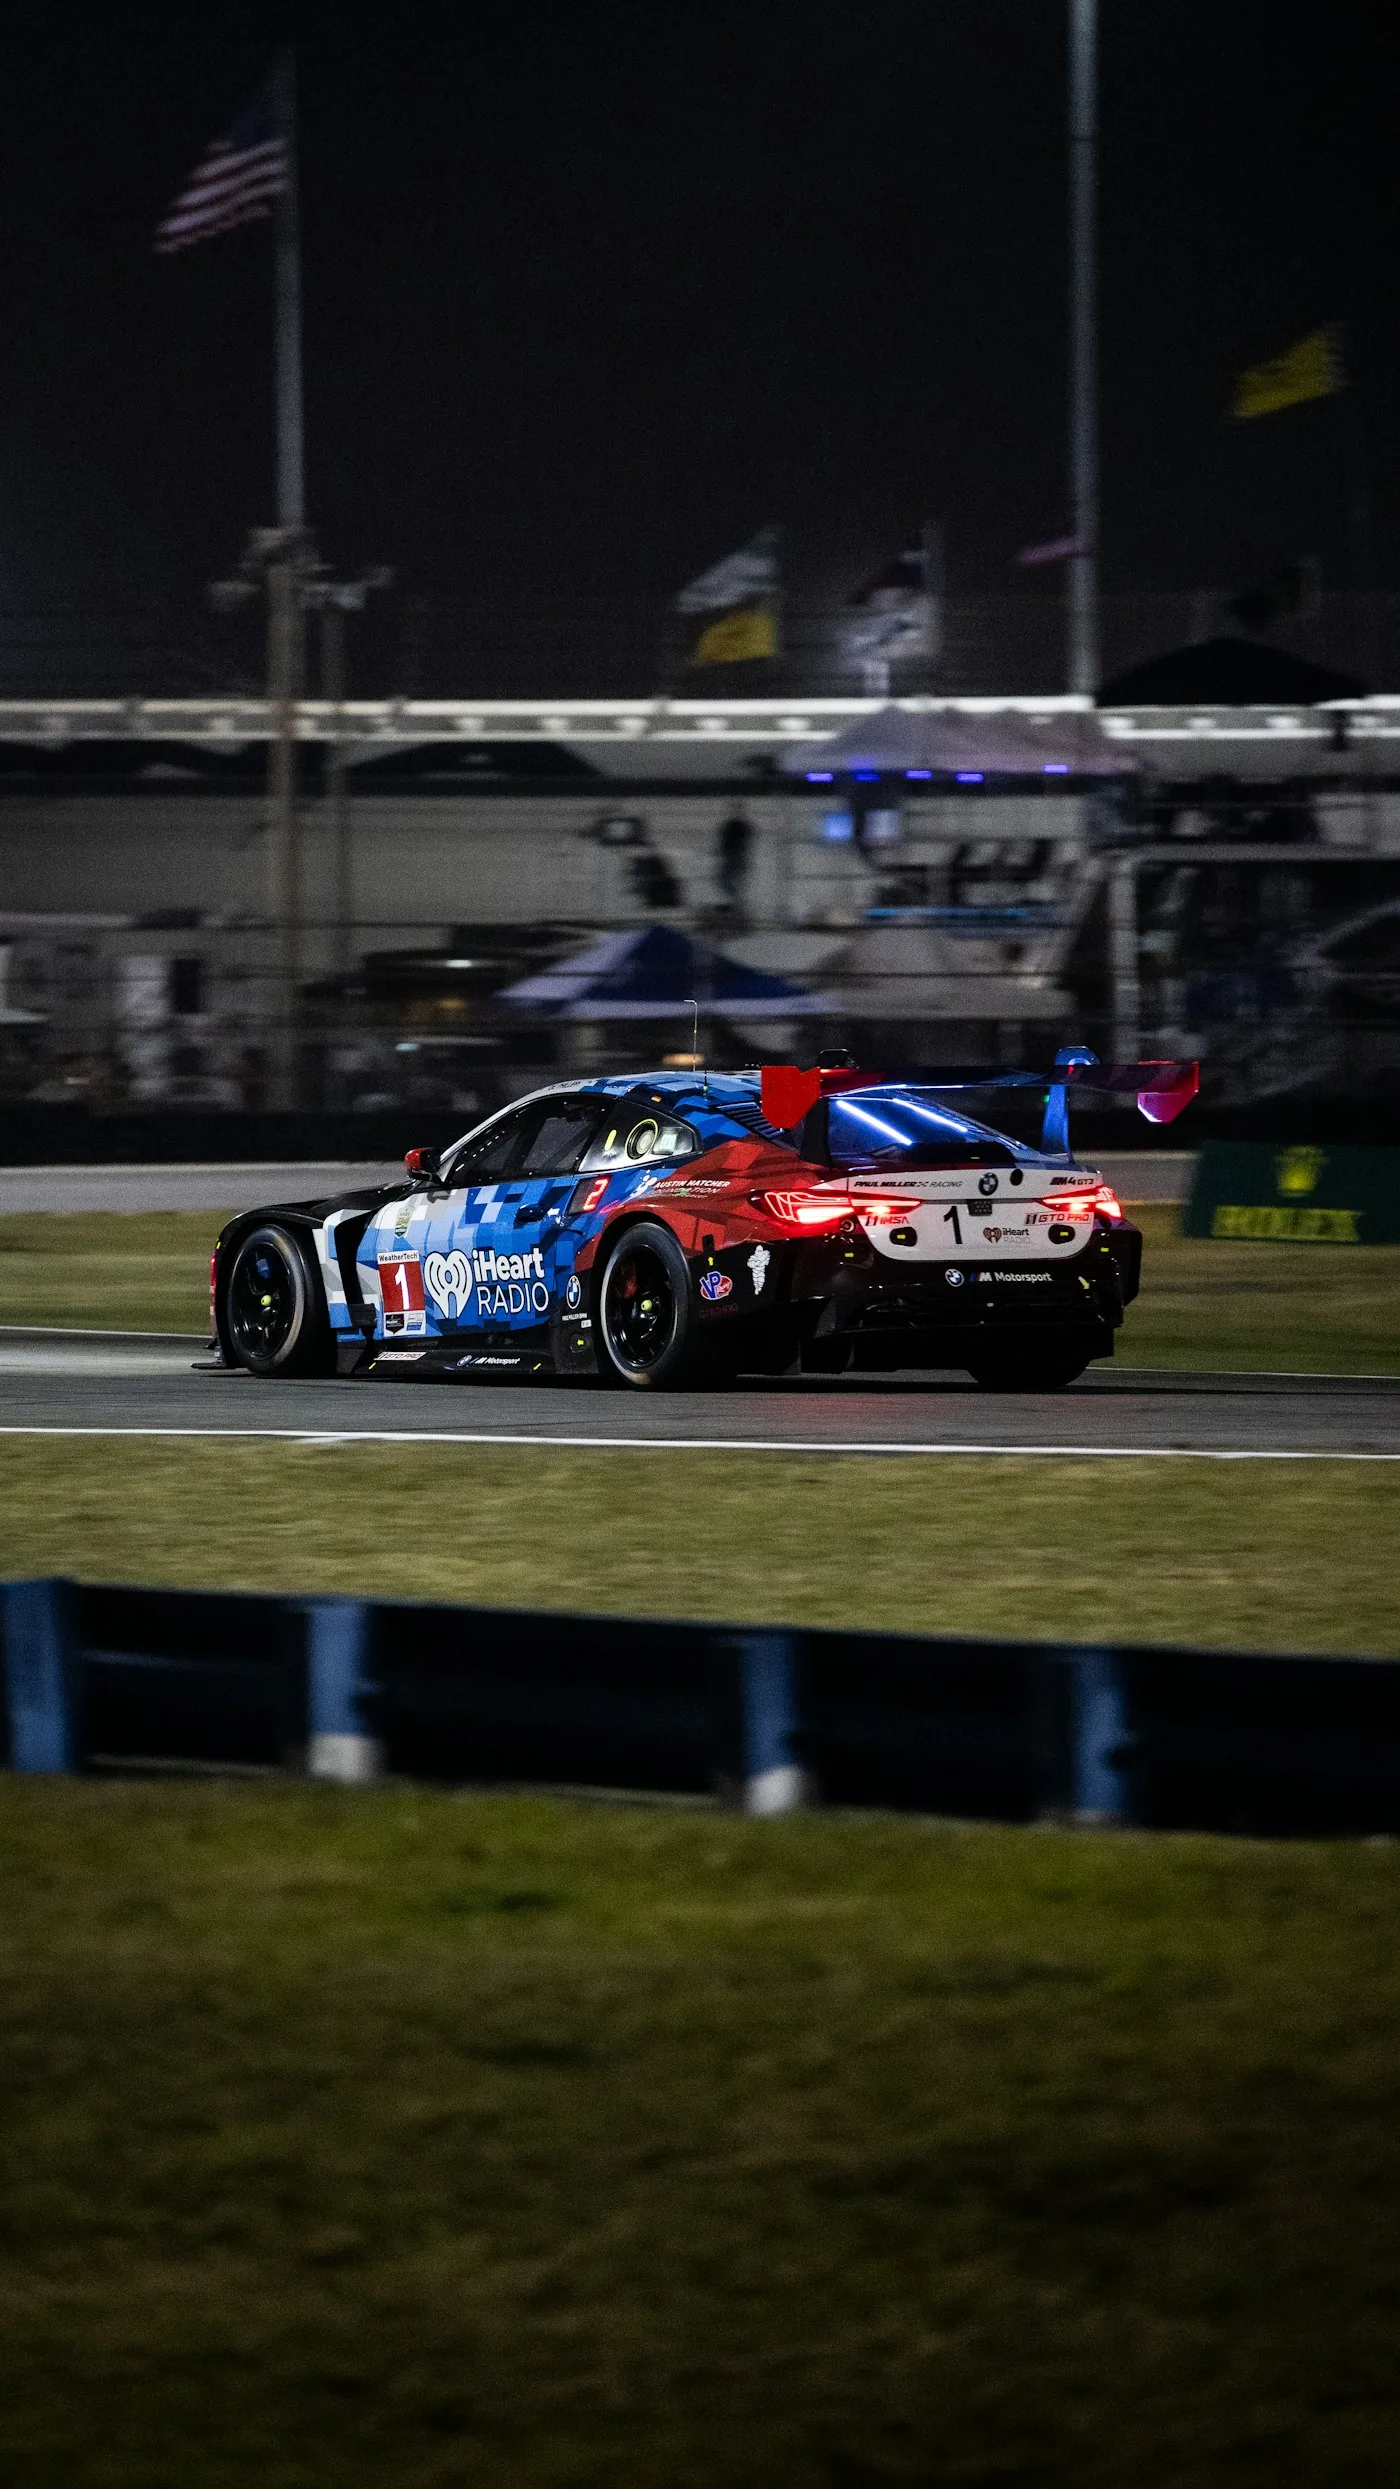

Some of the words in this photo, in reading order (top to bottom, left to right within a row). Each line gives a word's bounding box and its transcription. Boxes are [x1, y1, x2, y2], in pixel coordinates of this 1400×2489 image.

[582, 1178, 608, 1212] 2
[654, 1181, 688, 1189] AUSTIN
[688, 1179, 731, 1188] HATCHER
[943, 1206, 963, 1245] 1
[1002, 1227, 1030, 1237] iHeart
[1038, 1213, 1064, 1223] GTD
[1066, 1213, 1090, 1222] PRO
[379, 1252, 418, 1262] WeatherTech
[472, 1247, 545, 1283] iHeart
[395, 1263, 410, 1310] 1
[699, 1271, 723, 1300] VP
[994, 1271, 1053, 1284] Motorsport
[476, 1281, 549, 1316] RADIO
